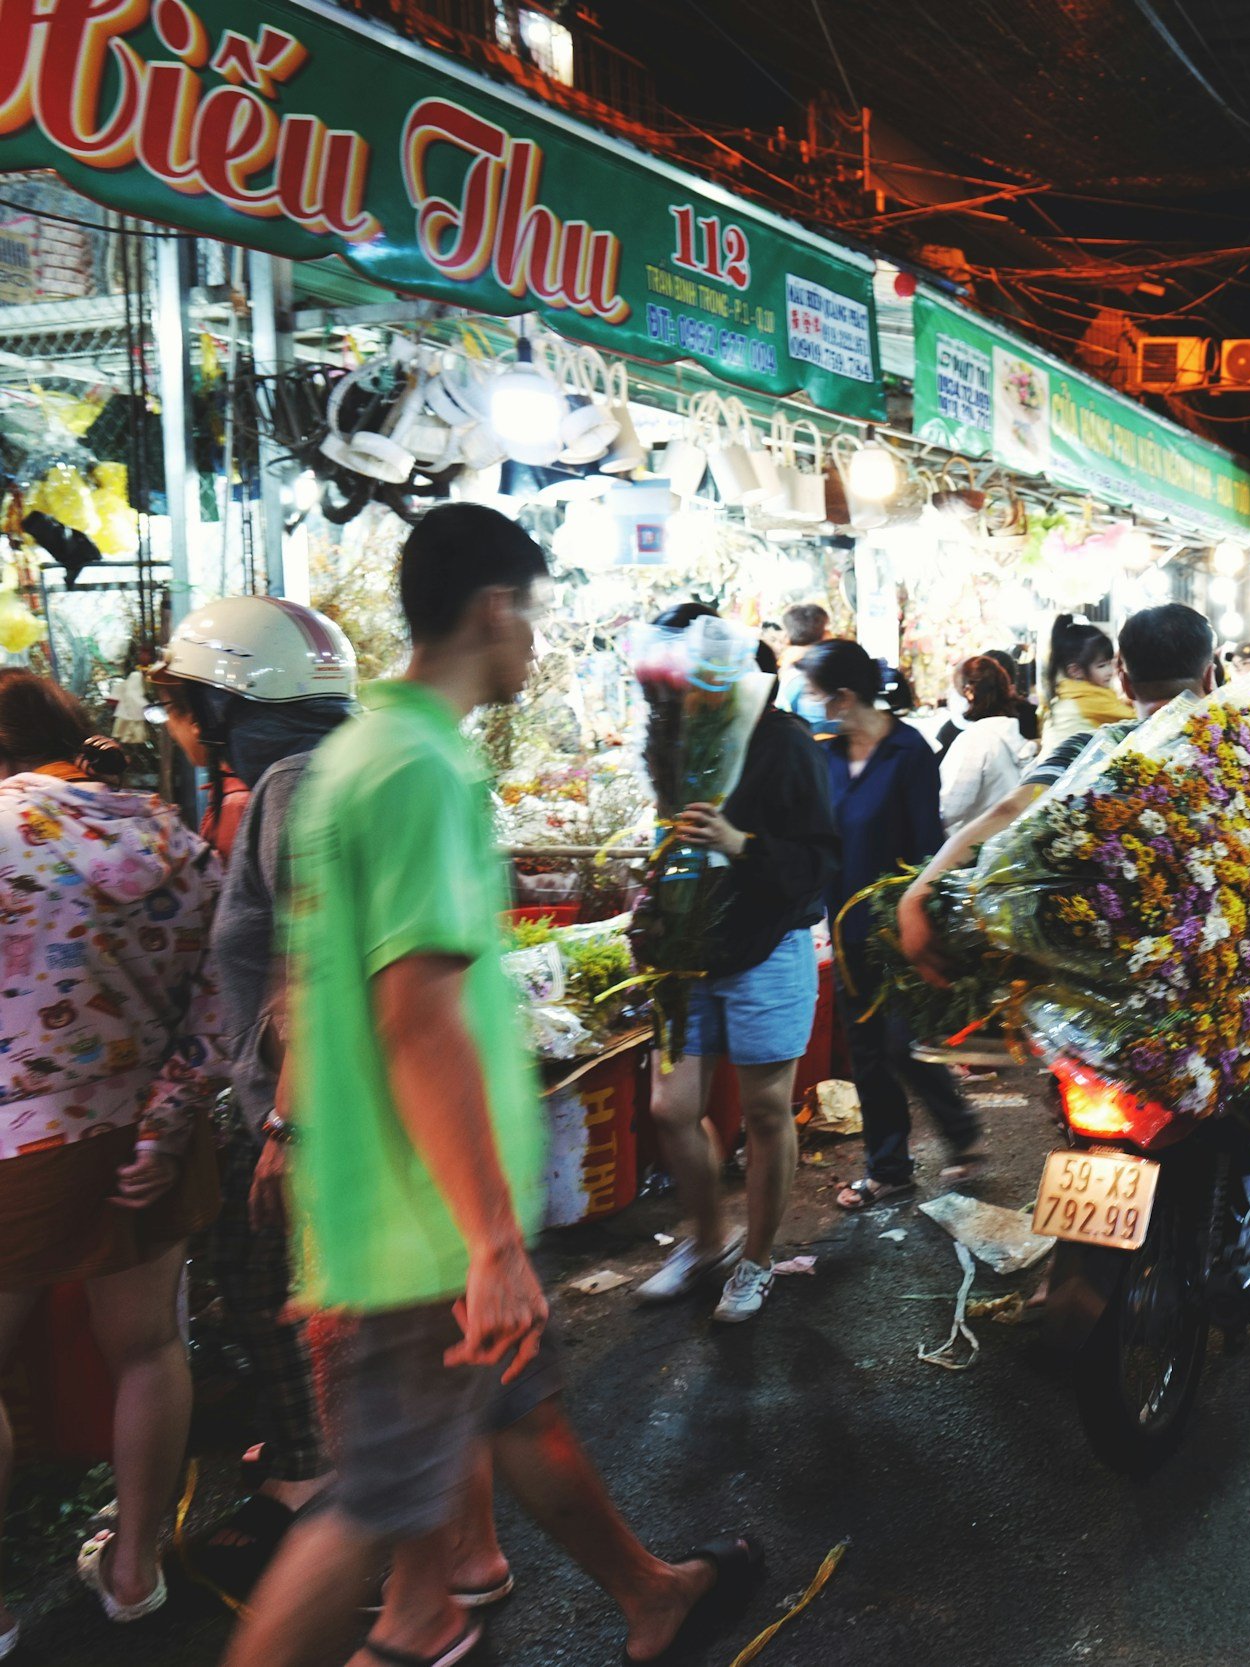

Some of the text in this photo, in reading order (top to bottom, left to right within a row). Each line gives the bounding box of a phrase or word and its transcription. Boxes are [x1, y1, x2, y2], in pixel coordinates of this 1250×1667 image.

[402, 97, 630, 324] Thu
[668, 203, 750, 291] 112
[1060, 1158, 1140, 1199] 59-X3
[1042, 1196, 1140, 1240] 792.99
